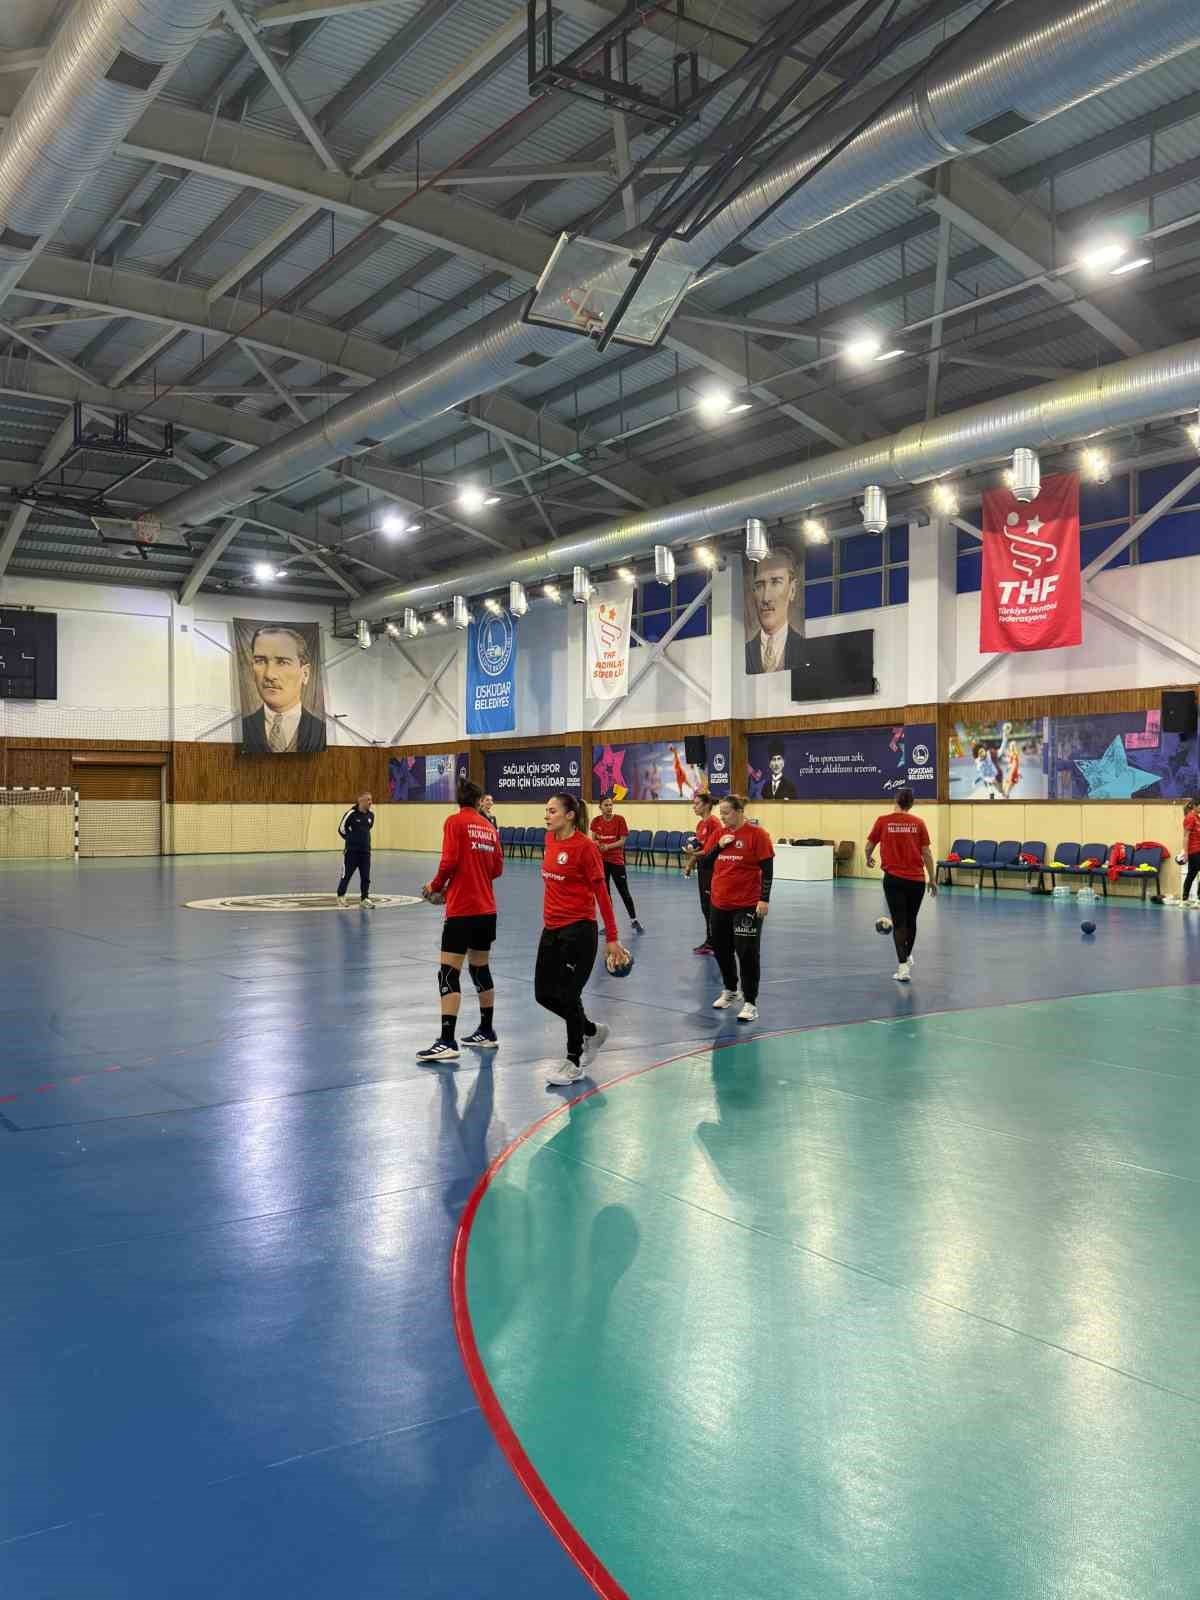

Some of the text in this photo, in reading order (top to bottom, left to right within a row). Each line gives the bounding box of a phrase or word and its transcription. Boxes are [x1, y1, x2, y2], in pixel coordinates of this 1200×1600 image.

[998, 575, 1059, 605] THF
[503, 761, 560, 777] SAĞLIK İÇİN SPOR
[498, 777, 516, 788] SPOR
[517, 775, 531, 790] İÇİN
[532, 775, 565, 788] ÜSKÜDAR
